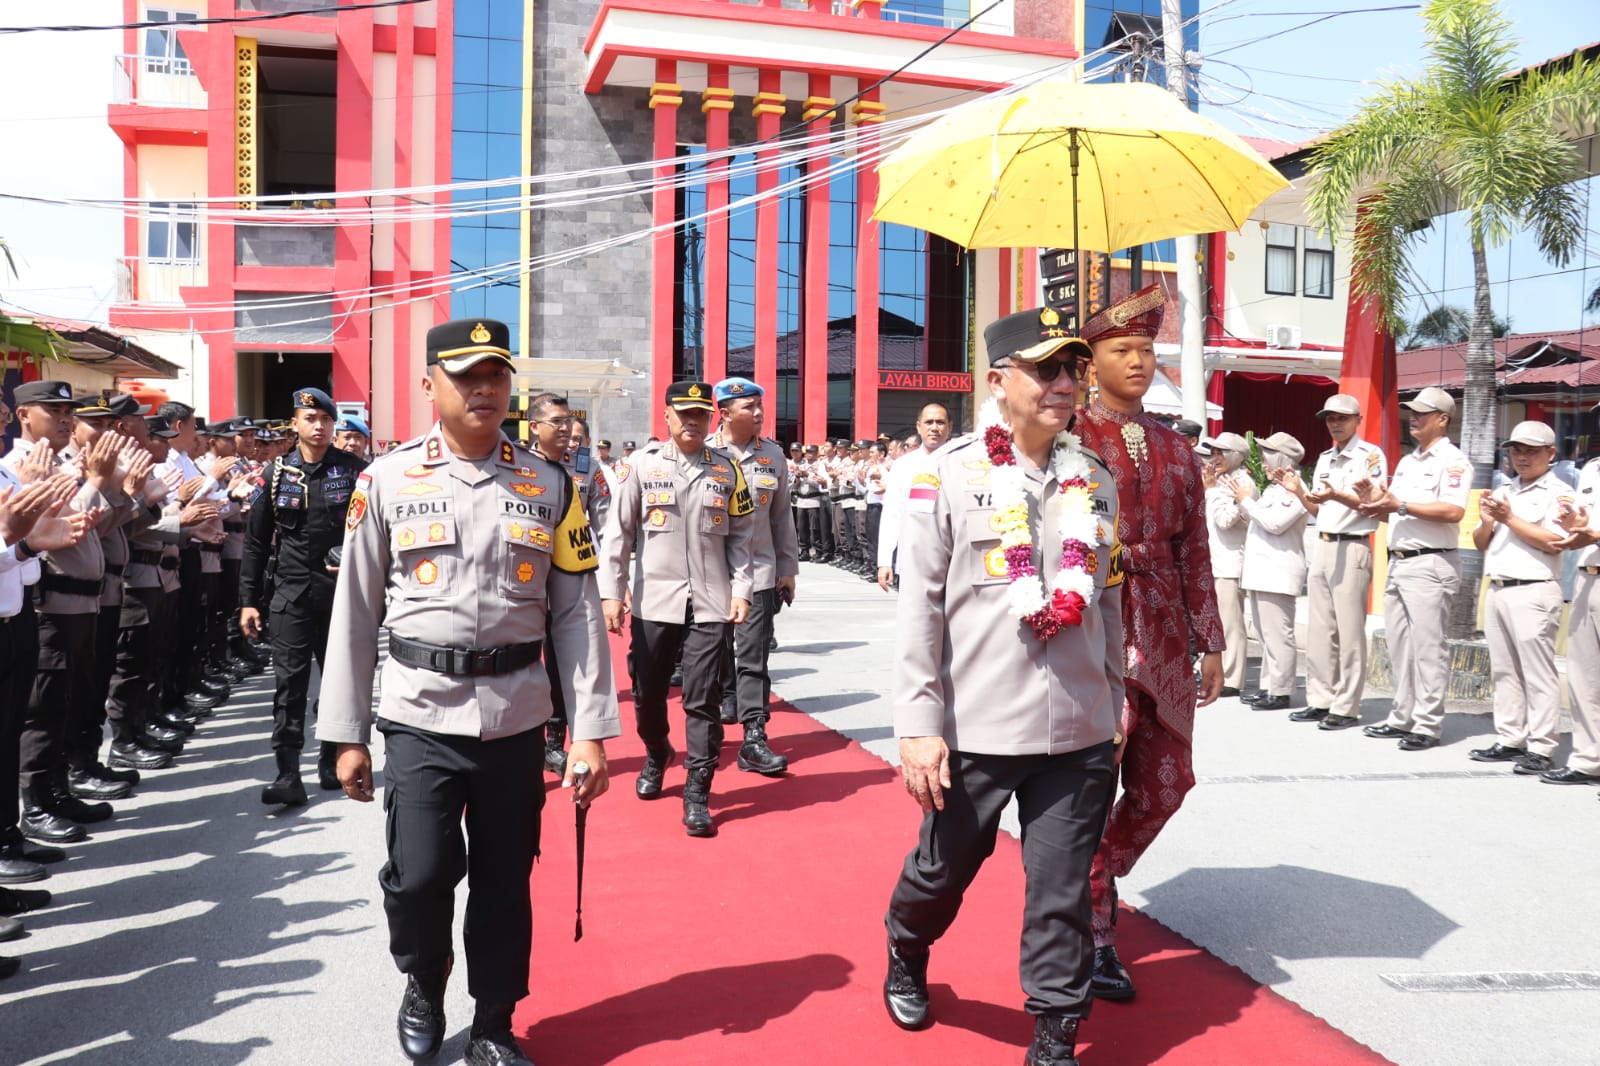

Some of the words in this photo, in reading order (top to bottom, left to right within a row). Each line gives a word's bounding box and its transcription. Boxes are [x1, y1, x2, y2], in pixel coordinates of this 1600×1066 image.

[927, 375, 969, 388] BIROK
[324, 480, 350, 490] POLRI
[395, 501, 447, 518] FADLI
[505, 501, 551, 520] POLRI
